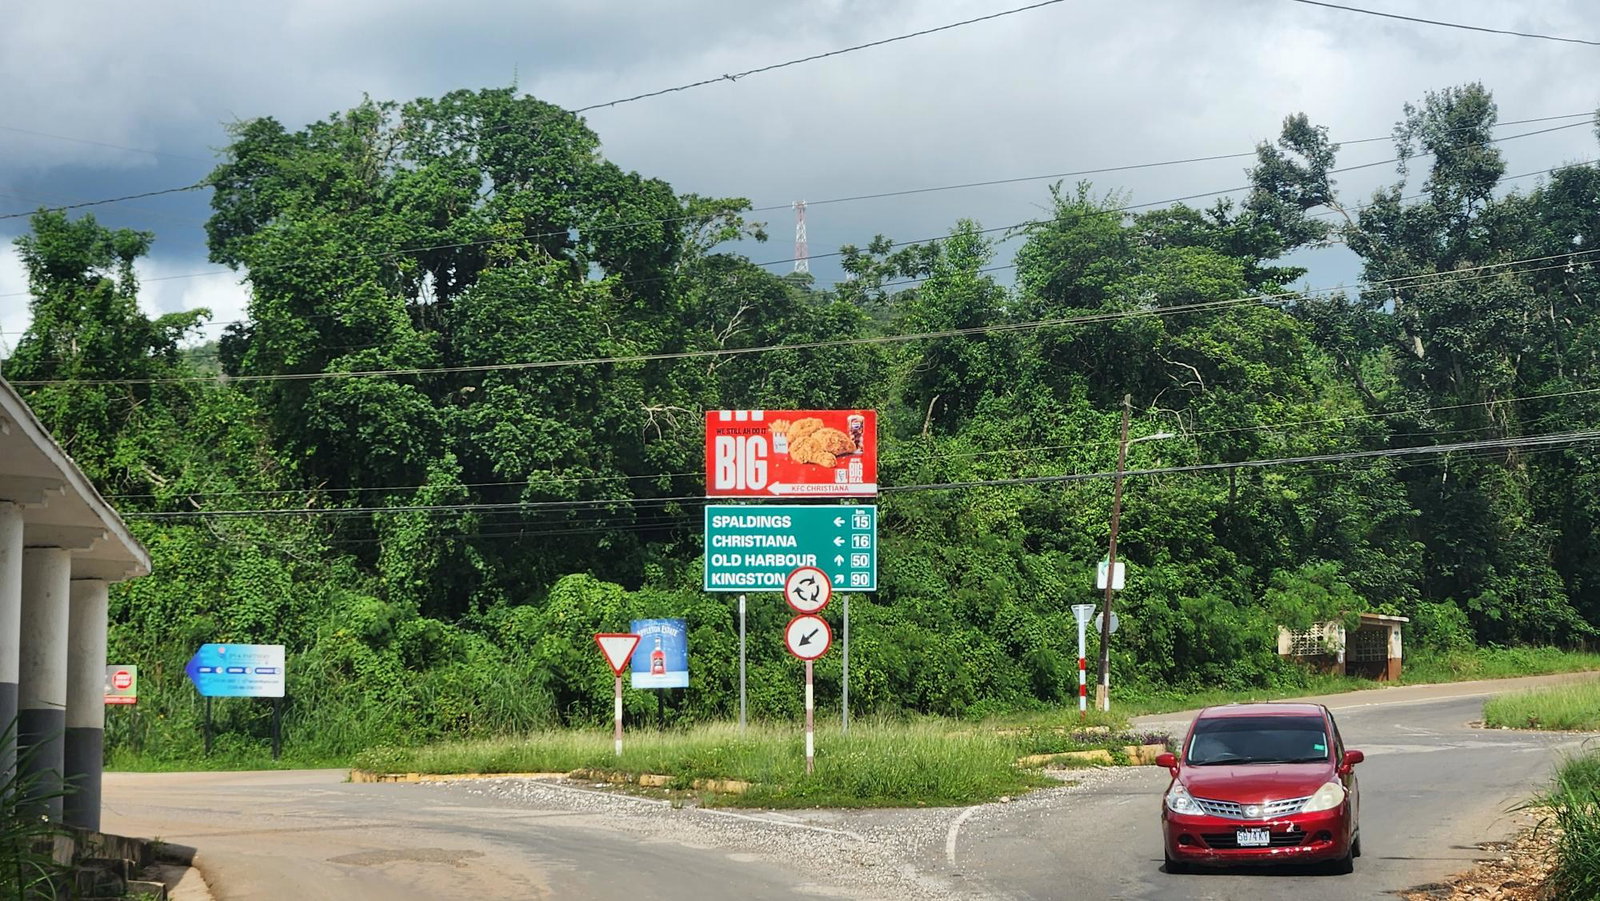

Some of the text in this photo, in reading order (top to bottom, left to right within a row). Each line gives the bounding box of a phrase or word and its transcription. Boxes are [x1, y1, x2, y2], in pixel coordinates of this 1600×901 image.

[715, 435, 768, 491] BIG
[712, 515, 869, 528] SPALDINGS 15
[712, 535, 869, 547] CHRISTIANA 16
[711, 554, 868, 567] OLD HARBOUR 50
[711, 573, 868, 586] KINGSTON 90
